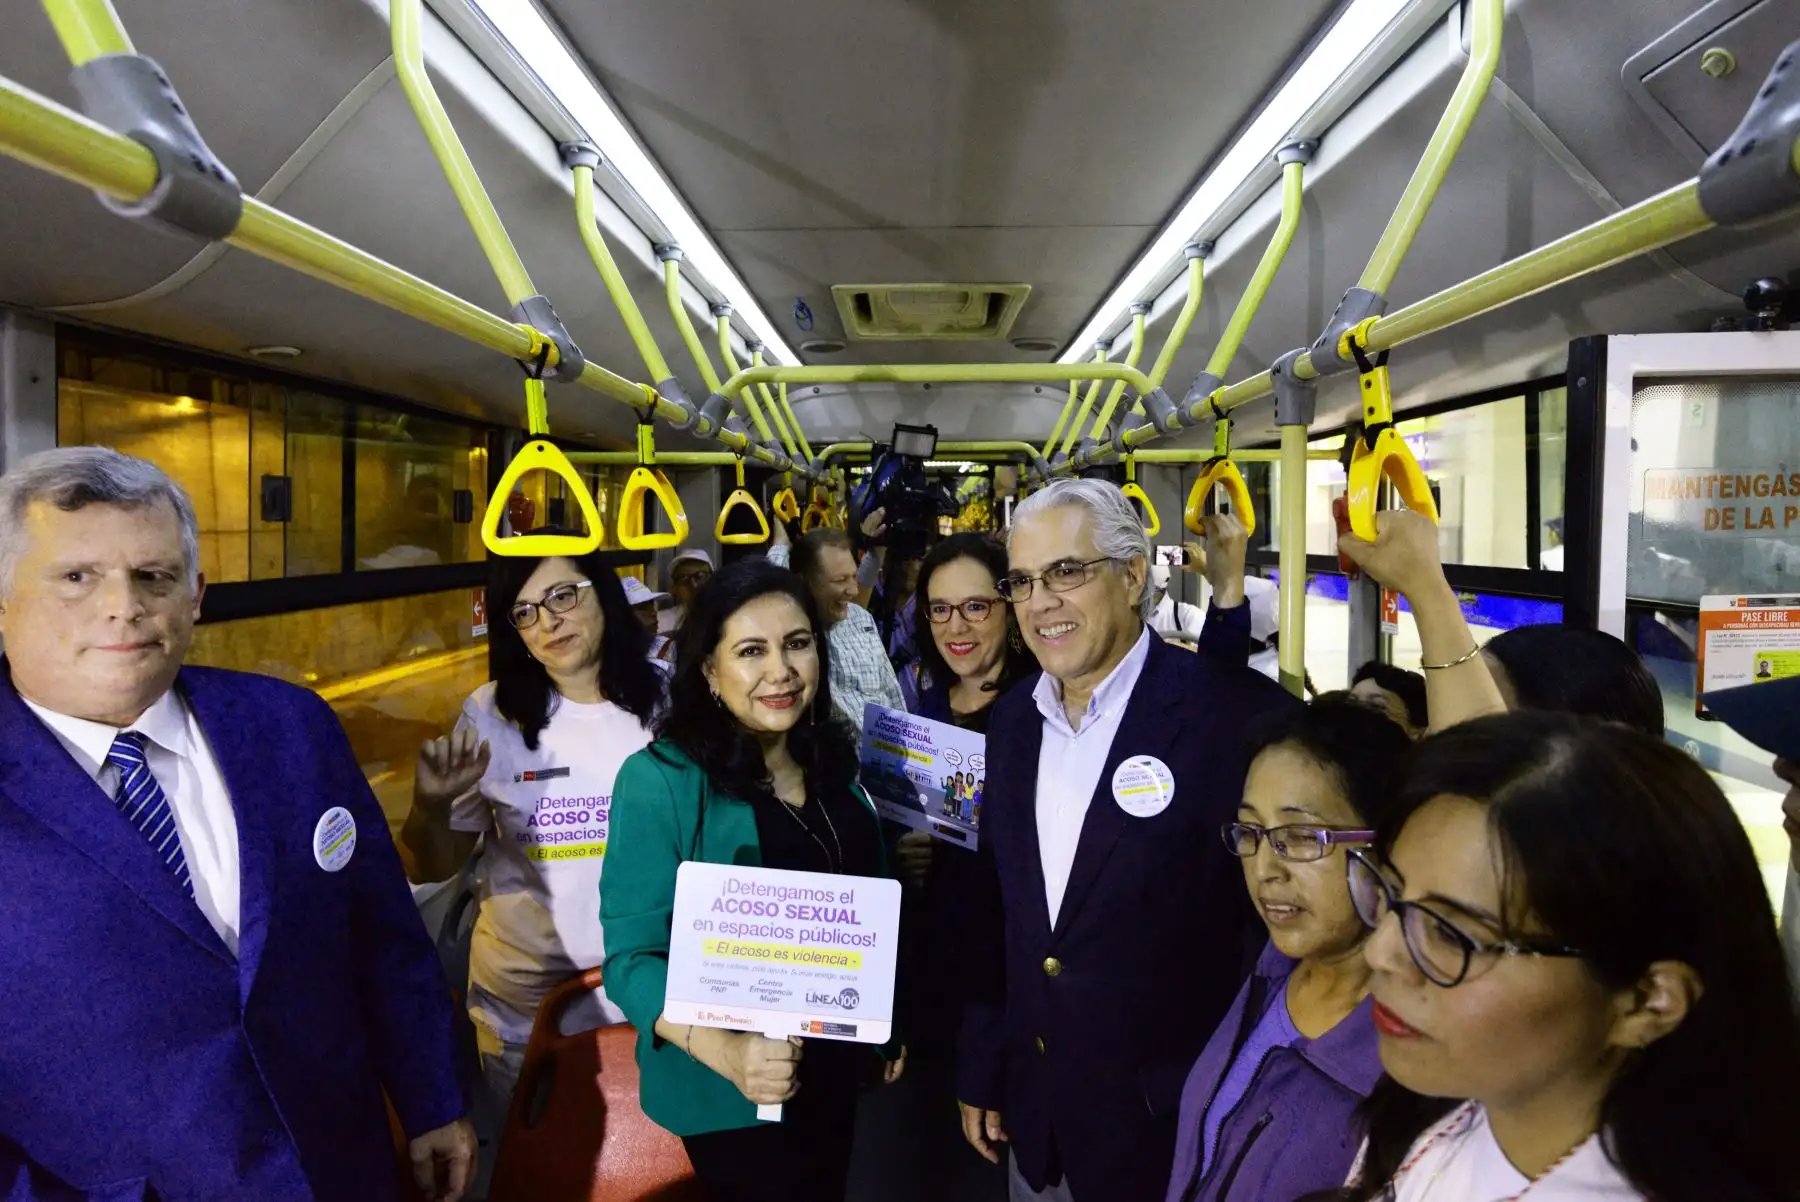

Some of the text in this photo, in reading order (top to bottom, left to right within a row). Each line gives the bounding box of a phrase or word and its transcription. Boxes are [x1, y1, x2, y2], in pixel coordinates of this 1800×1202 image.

[1704, 506, 1735, 531] DE
[1745, 506, 1775, 530] LA
[1741, 611, 1788, 622] PASE LIBRE
[875, 720, 932, 744] ACOSO SEXUAL
[527, 810, 609, 827] ACOSO S
[516, 828, 606, 844] en espacios
[537, 846, 603, 859] El acoso es
[722, 878, 854, 904] ¡Detengamos el
[711, 897, 861, 925] ACOSO SEXUAL
[693, 918, 876, 948] en espacios públicos!
[716, 941, 729, 954] El
[732, 944, 770, 958] acoso
[774, 949, 788, 959] es
[793, 951, 848, 967] violencia
[710, 985, 727, 994] PNP
[749, 985, 793, 996] Emergencia
[758, 978, 783, 987] Centro
